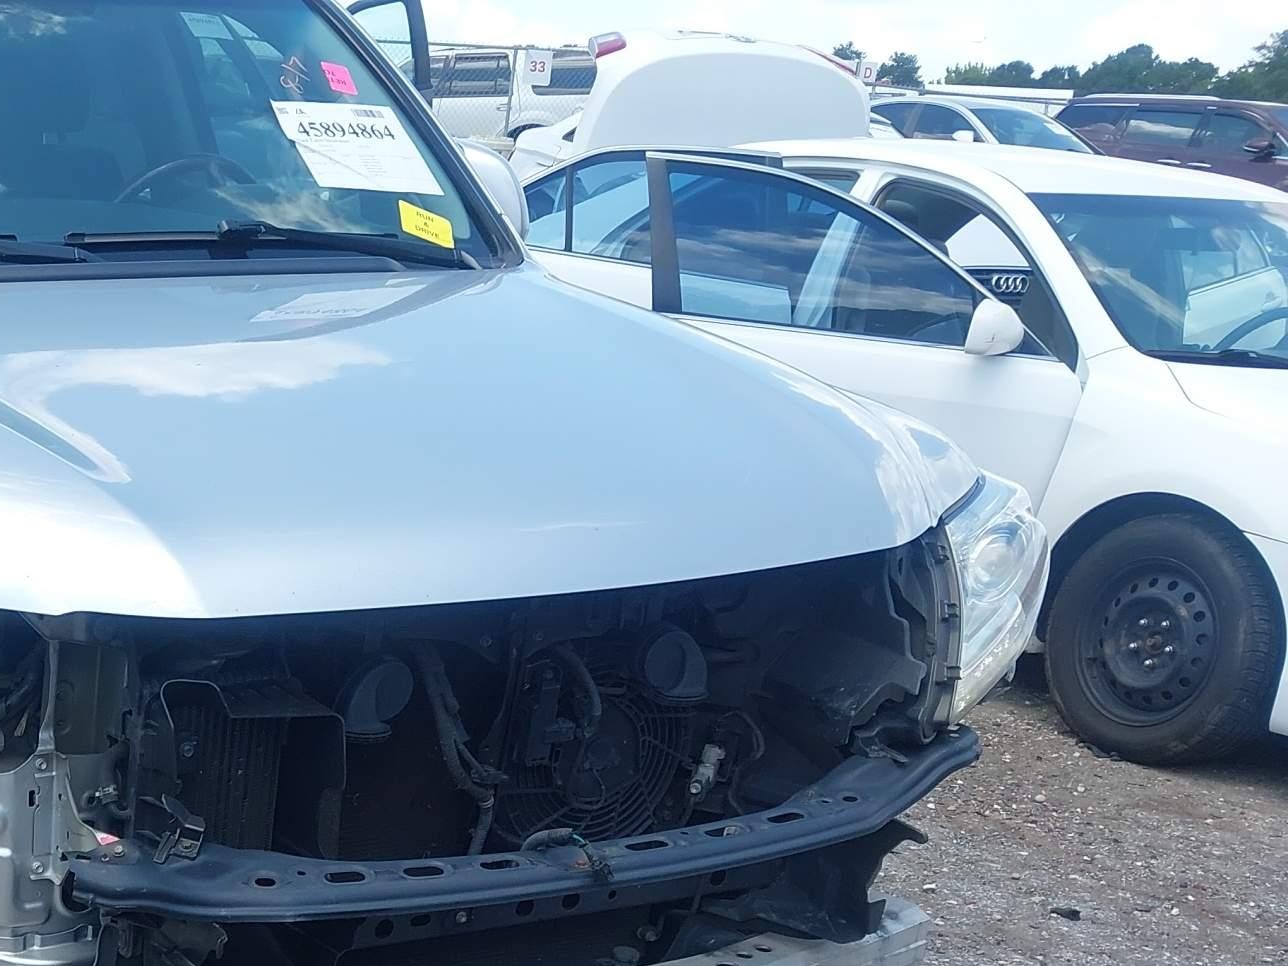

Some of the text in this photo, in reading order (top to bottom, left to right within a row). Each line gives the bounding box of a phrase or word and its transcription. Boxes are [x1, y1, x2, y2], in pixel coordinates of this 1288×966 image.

[529, 60, 546, 73] 33
[863, 66, 872, 79] D
[297, 121, 396, 140] 45894864
